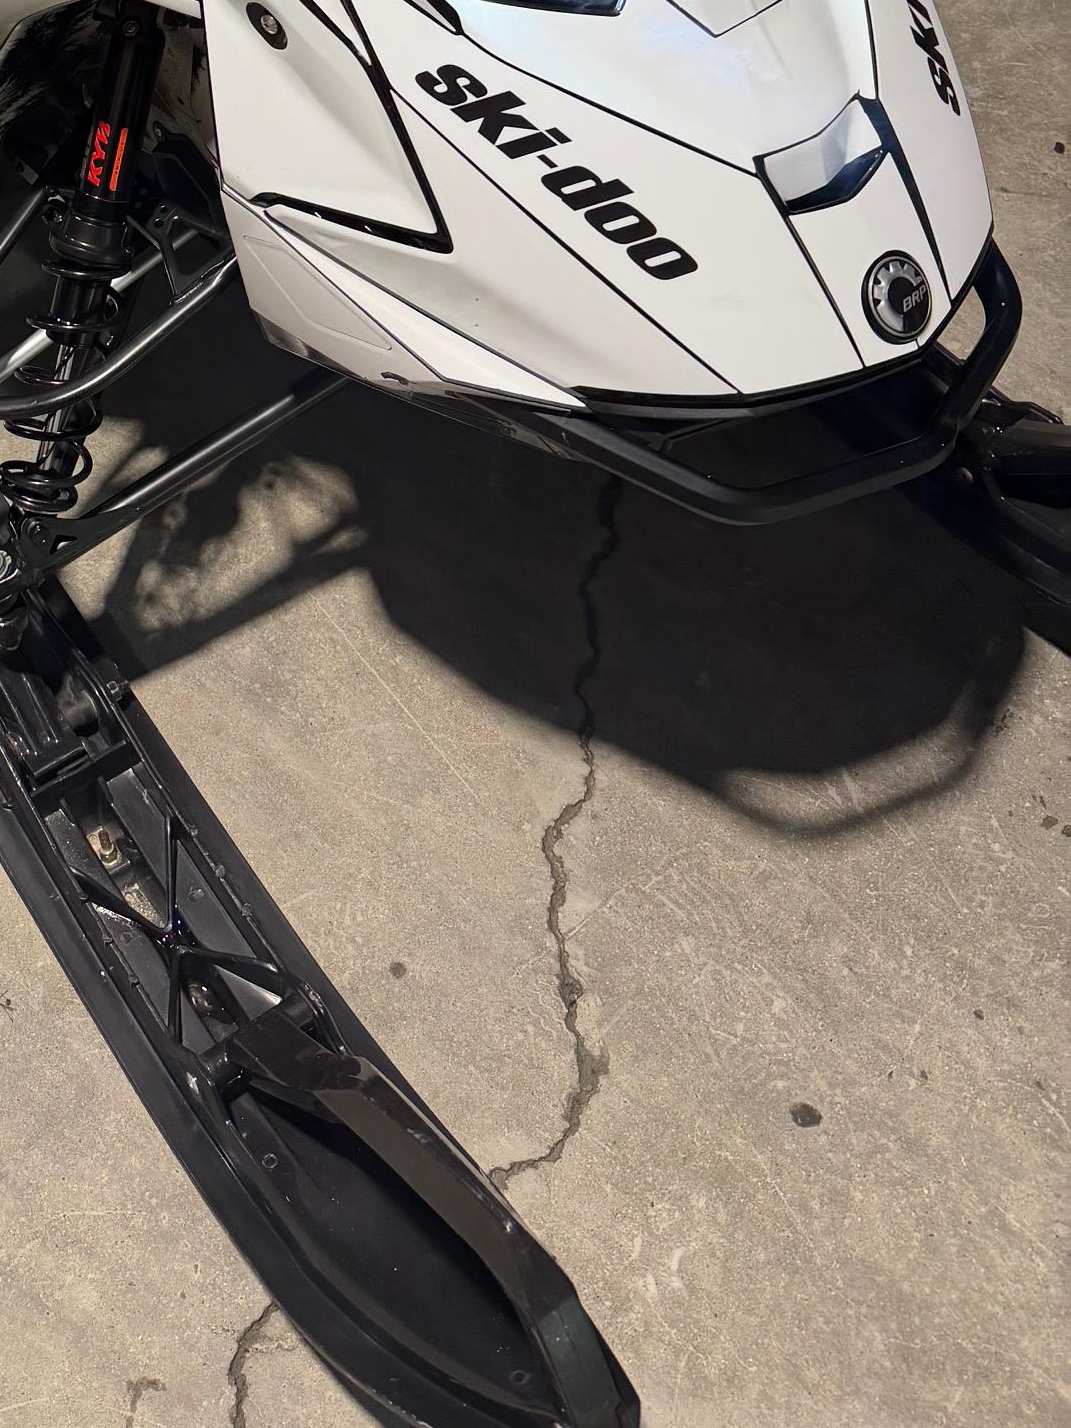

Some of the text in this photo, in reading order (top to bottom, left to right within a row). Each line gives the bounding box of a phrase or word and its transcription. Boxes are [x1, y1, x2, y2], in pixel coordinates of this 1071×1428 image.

[87, 121, 110, 187] KYB
[415, 64, 698, 280] ski-doo
[903, 285, 926, 312] BRP
